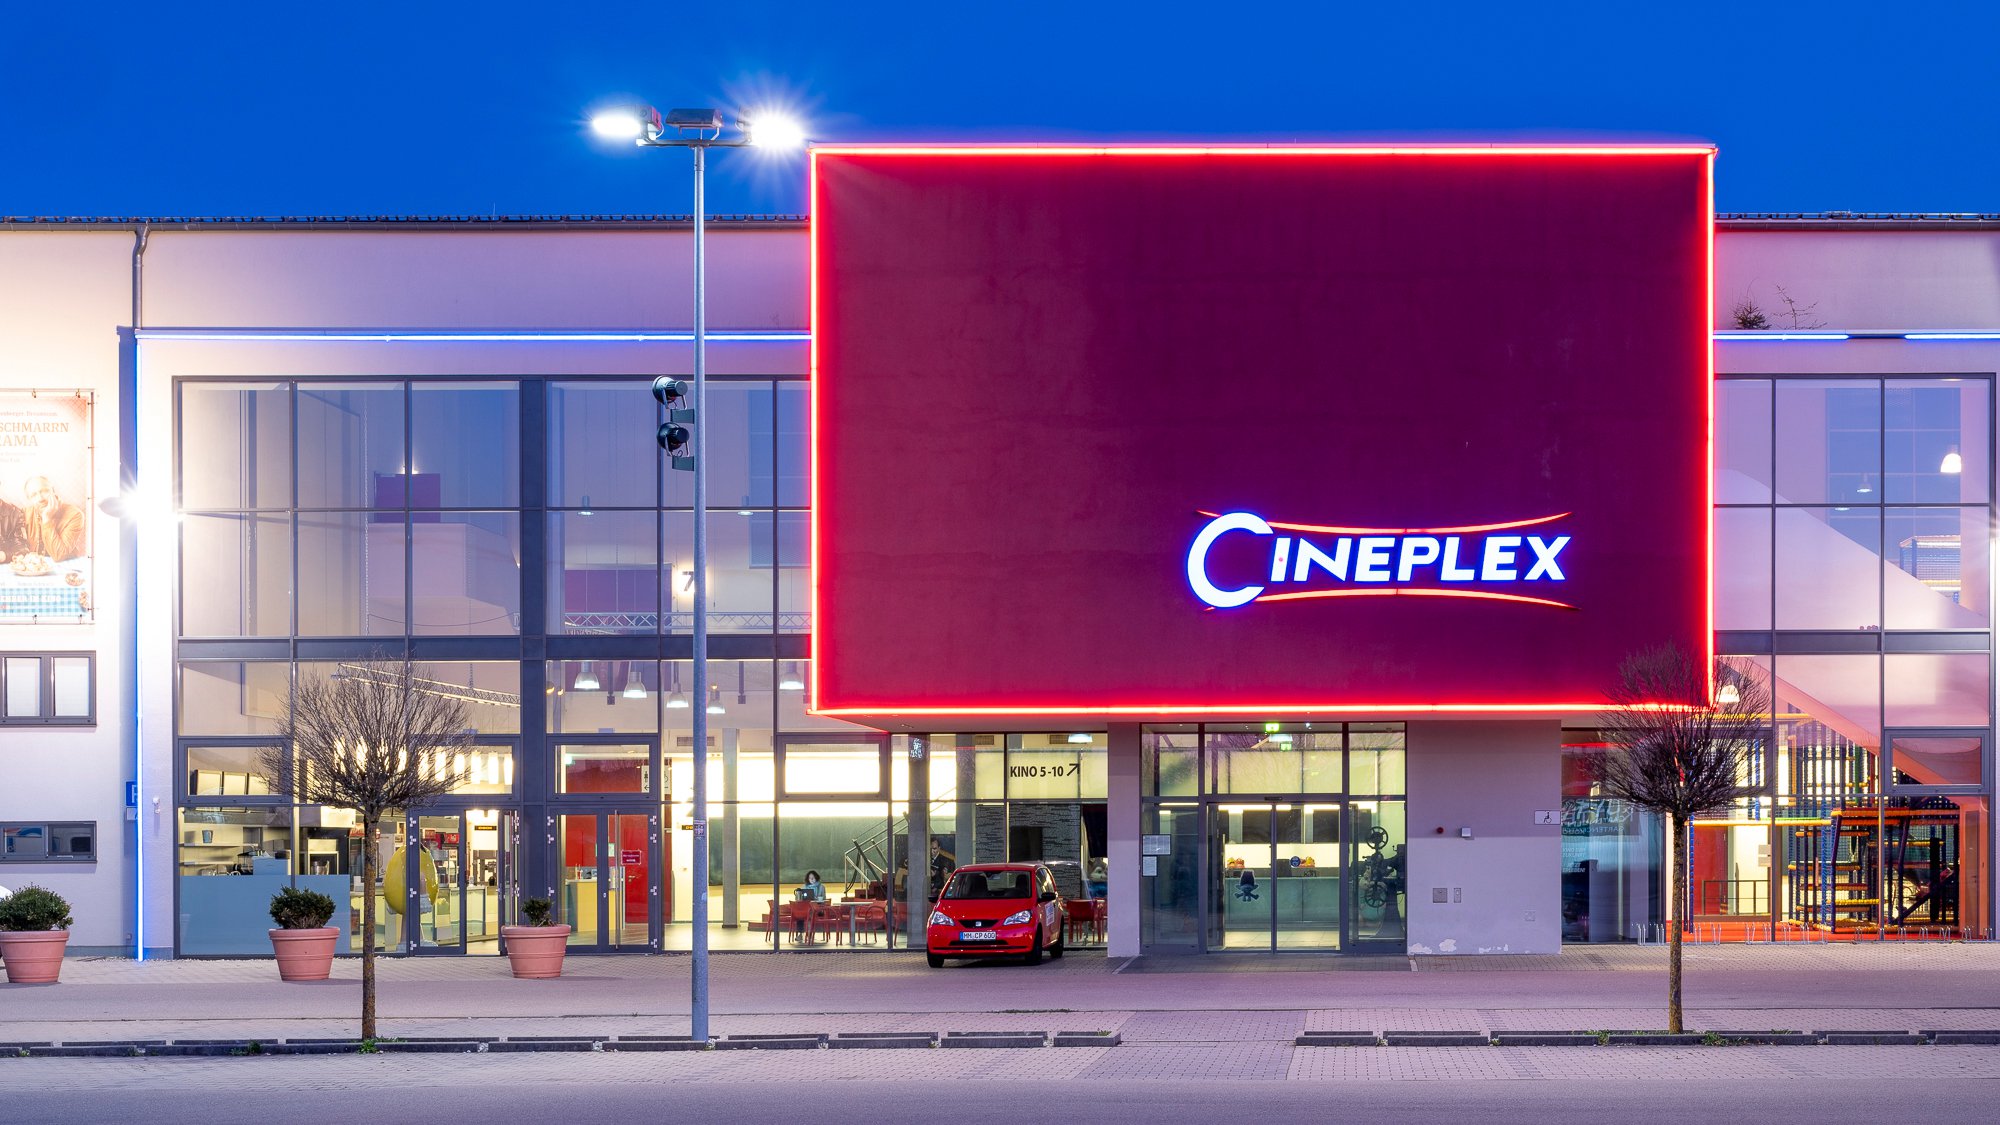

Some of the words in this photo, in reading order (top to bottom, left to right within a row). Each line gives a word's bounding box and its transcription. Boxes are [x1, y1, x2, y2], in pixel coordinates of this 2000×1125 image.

[0, 422, 69, 433] SCHMARRN
[0, 434, 38, 447] AMA
[1187, 512, 1571, 608] CINEPLEX
[682, 571, 694, 592] 7
[1010, 766, 1038, 778] KINO
